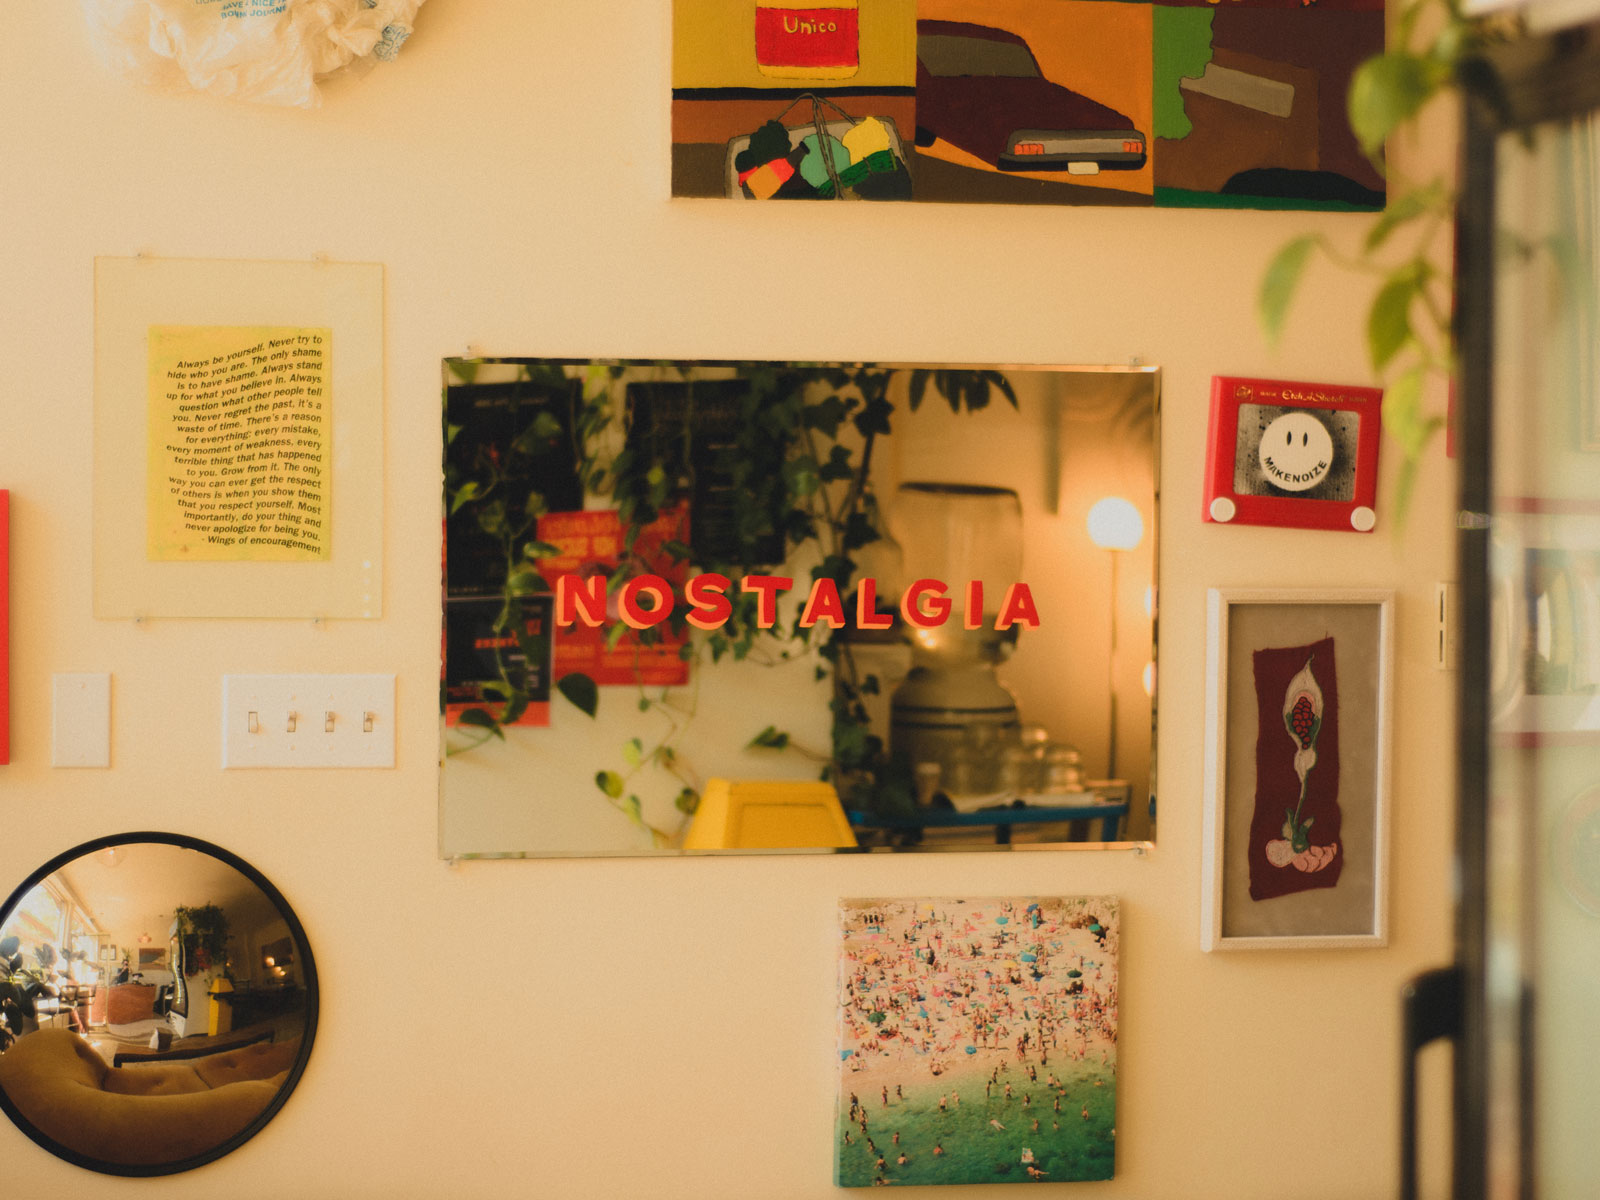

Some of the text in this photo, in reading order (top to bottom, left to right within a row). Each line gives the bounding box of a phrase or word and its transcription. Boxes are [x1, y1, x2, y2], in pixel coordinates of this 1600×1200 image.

[784, 16, 837, 34] Unico
[177, 359, 209, 369] Always
[213, 356, 223, 365] be
[269, 337, 294, 349] Never
[298, 336, 310, 344] try
[313, 335, 322, 344] to
[168, 347, 322, 379] hide who you are. The only shame
[189, 381, 197, 389] to
[201, 379, 222, 389] have
[225, 372, 257, 384] shame.
[261, 362, 293, 375] Always
[297, 361, 322, 370] stand
[166, 374, 322, 400] up for what you believe in. Always
[179, 386, 322, 412] question what other people tell
[172, 414, 191, 422] you.
[195, 414, 221, 422] Never
[224, 407, 251, 418] regret
[255, 403, 269, 412] the
[178, 424, 204, 433] waste
[208, 423, 217, 432] of
[220, 421, 242, 431] time.
[247, 413, 279, 426] There's
[291, 413, 321, 422] reason
[186, 436, 198, 444] for
[255, 427, 278, 437] every
[282, 424, 321, 436] mistake,
[166, 444, 191, 455] every
[194, 445, 231, 455] moment
[234, 443, 244, 451] of
[297, 439, 321, 450] every
[174, 456, 207, 465] terrible
[211, 456, 233, 465] thing
[237, 454, 255, 462] that
[278, 450, 321, 462] happened
[199, 469, 217, 477] you.
[221, 467, 244, 476] Grow
[247, 464, 267, 473] from
[271, 463, 279, 471] it.
[284, 462, 299, 471] The
[303, 465, 321, 476] only
[1264, 456, 1327, 483] MAKENOIZE
[169, 475, 321, 488] way you can ever get the respect
[183, 490, 211, 499] others
[226, 489, 249, 498] when
[252, 488, 268, 497] you
[271, 486, 295, 496] show
[298, 489, 321, 501] them
[178, 499, 196, 508] that
[200, 503, 215, 511] you
[219, 501, 253, 510] respect
[298, 502, 320, 514] Most
[184, 511, 238, 522] importantly,
[256, 513, 275, 522] your
[279, 512, 301, 524] thing
[304, 518, 321, 527] and
[186, 522, 320, 541] never apologize for being you.
[208, 535, 235, 545] Wings
[238, 535, 248, 544] of
[250, 537, 320, 554] encouragement
[556, 573, 1040, 631] NOSTALGIA
